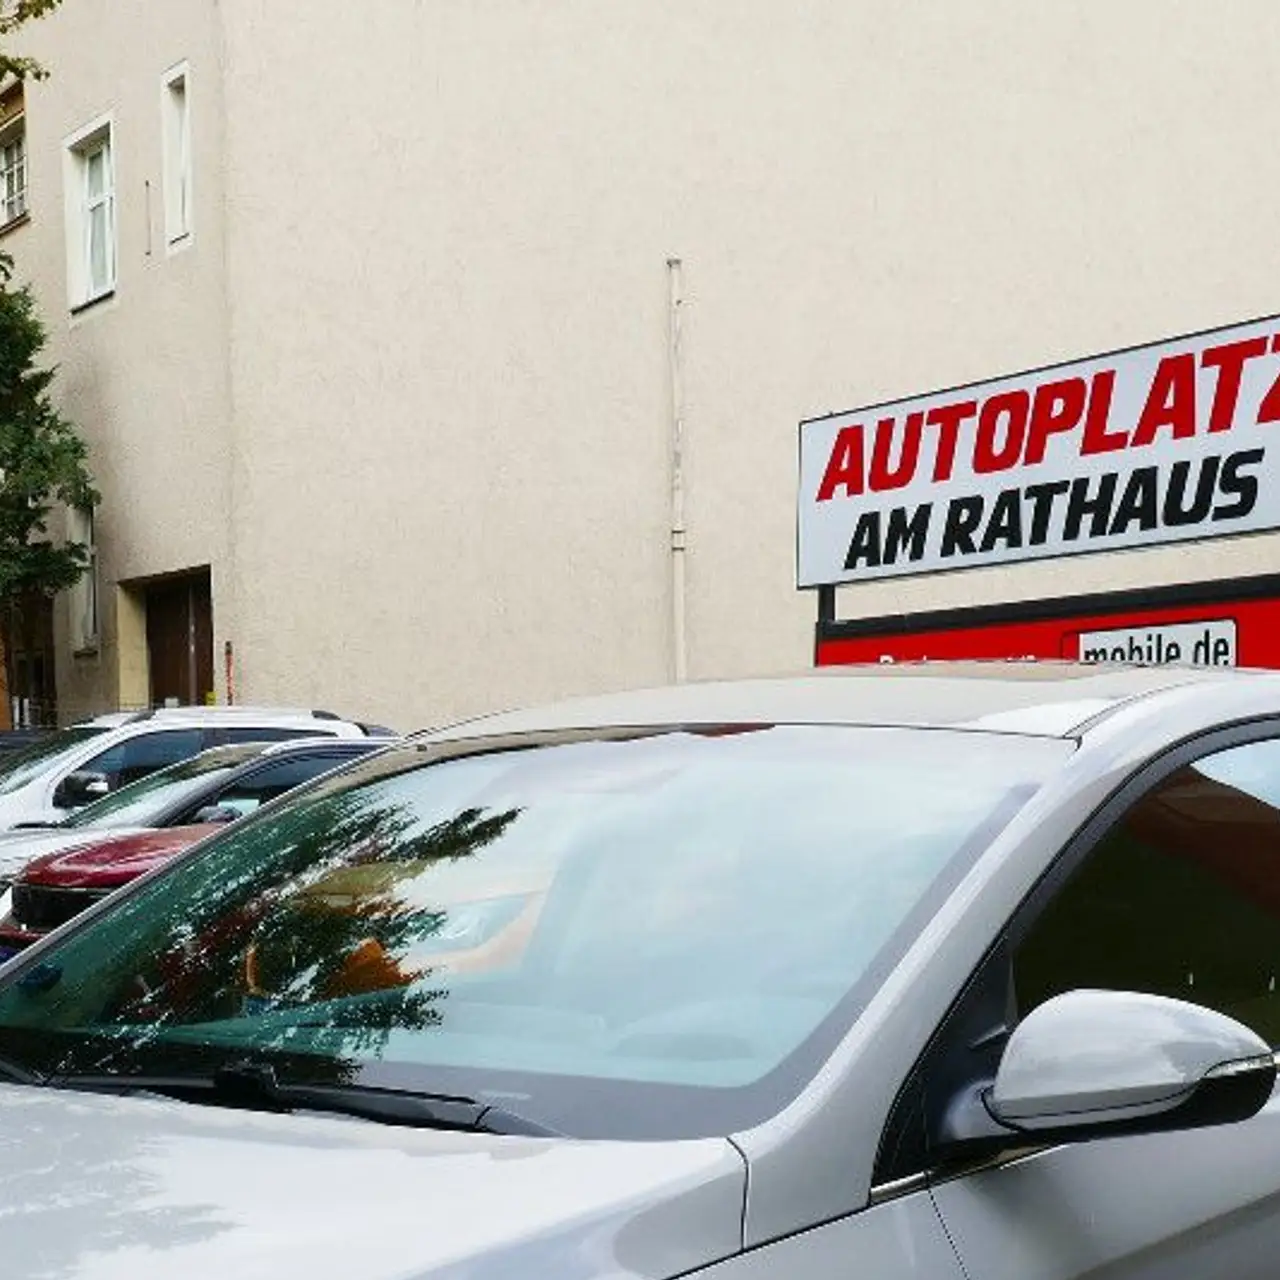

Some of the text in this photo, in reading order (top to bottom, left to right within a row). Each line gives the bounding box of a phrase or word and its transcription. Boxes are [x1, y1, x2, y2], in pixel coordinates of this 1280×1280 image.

[843, 448, 1265, 570] AM RATHAUS
[1084, 629, 1230, 666] mobilede
